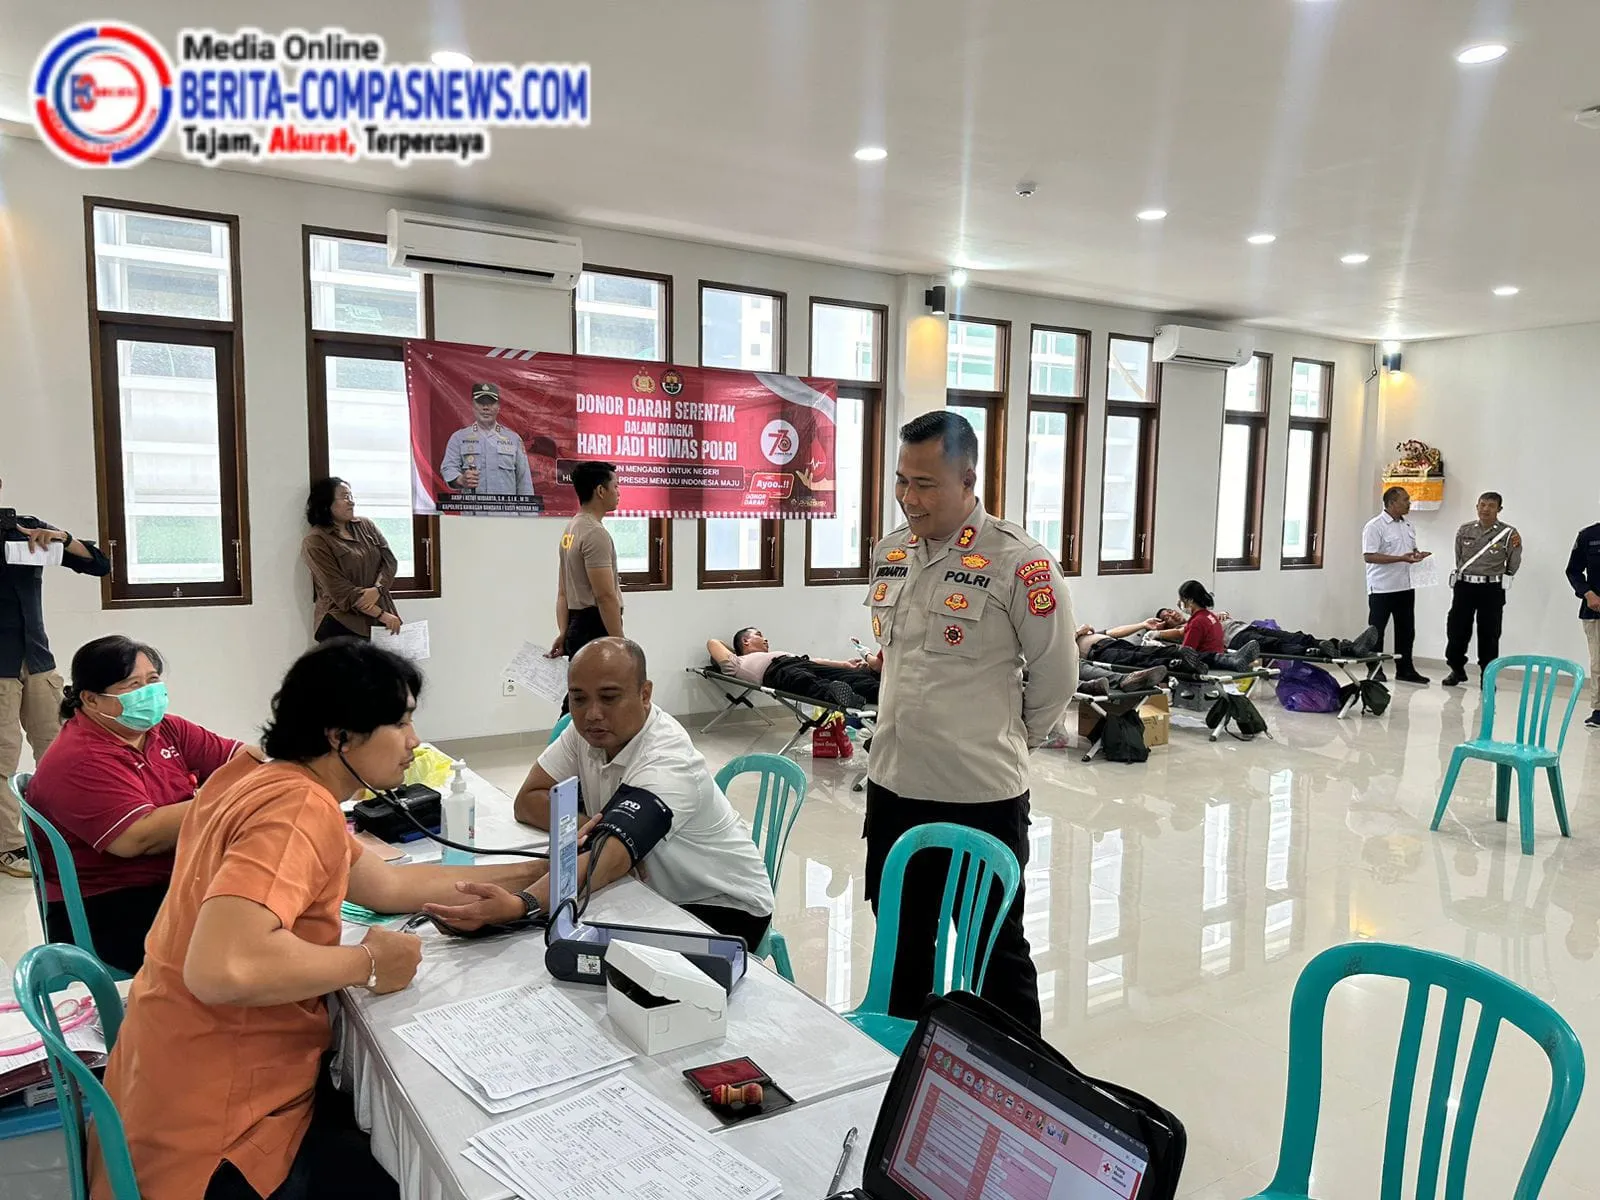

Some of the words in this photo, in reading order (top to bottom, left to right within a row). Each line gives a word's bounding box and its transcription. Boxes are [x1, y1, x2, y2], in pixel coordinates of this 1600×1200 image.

[576, 393, 624, 415] DONOR
[628, 398, 671, 418] DARAH
[675, 401, 736, 423] SERENTAK
[624, 420, 656, 435] DALAM
[658, 423, 694, 437] RANGKA
[577, 433, 612, 455] HARI
[615, 435, 645, 457] JADI
[648, 437, 698, 459] HUMAS
[701, 440, 737, 461] POLRI
[626, 465, 666, 473] MENGABDI
[619, 476, 648, 484] PRESISI
[649, 477, 680, 485] MENUJU
[681, 478, 719, 486] INDONESIA
[1020, 560, 1048, 576] POLRES
[944, 570, 991, 588] POLRI
